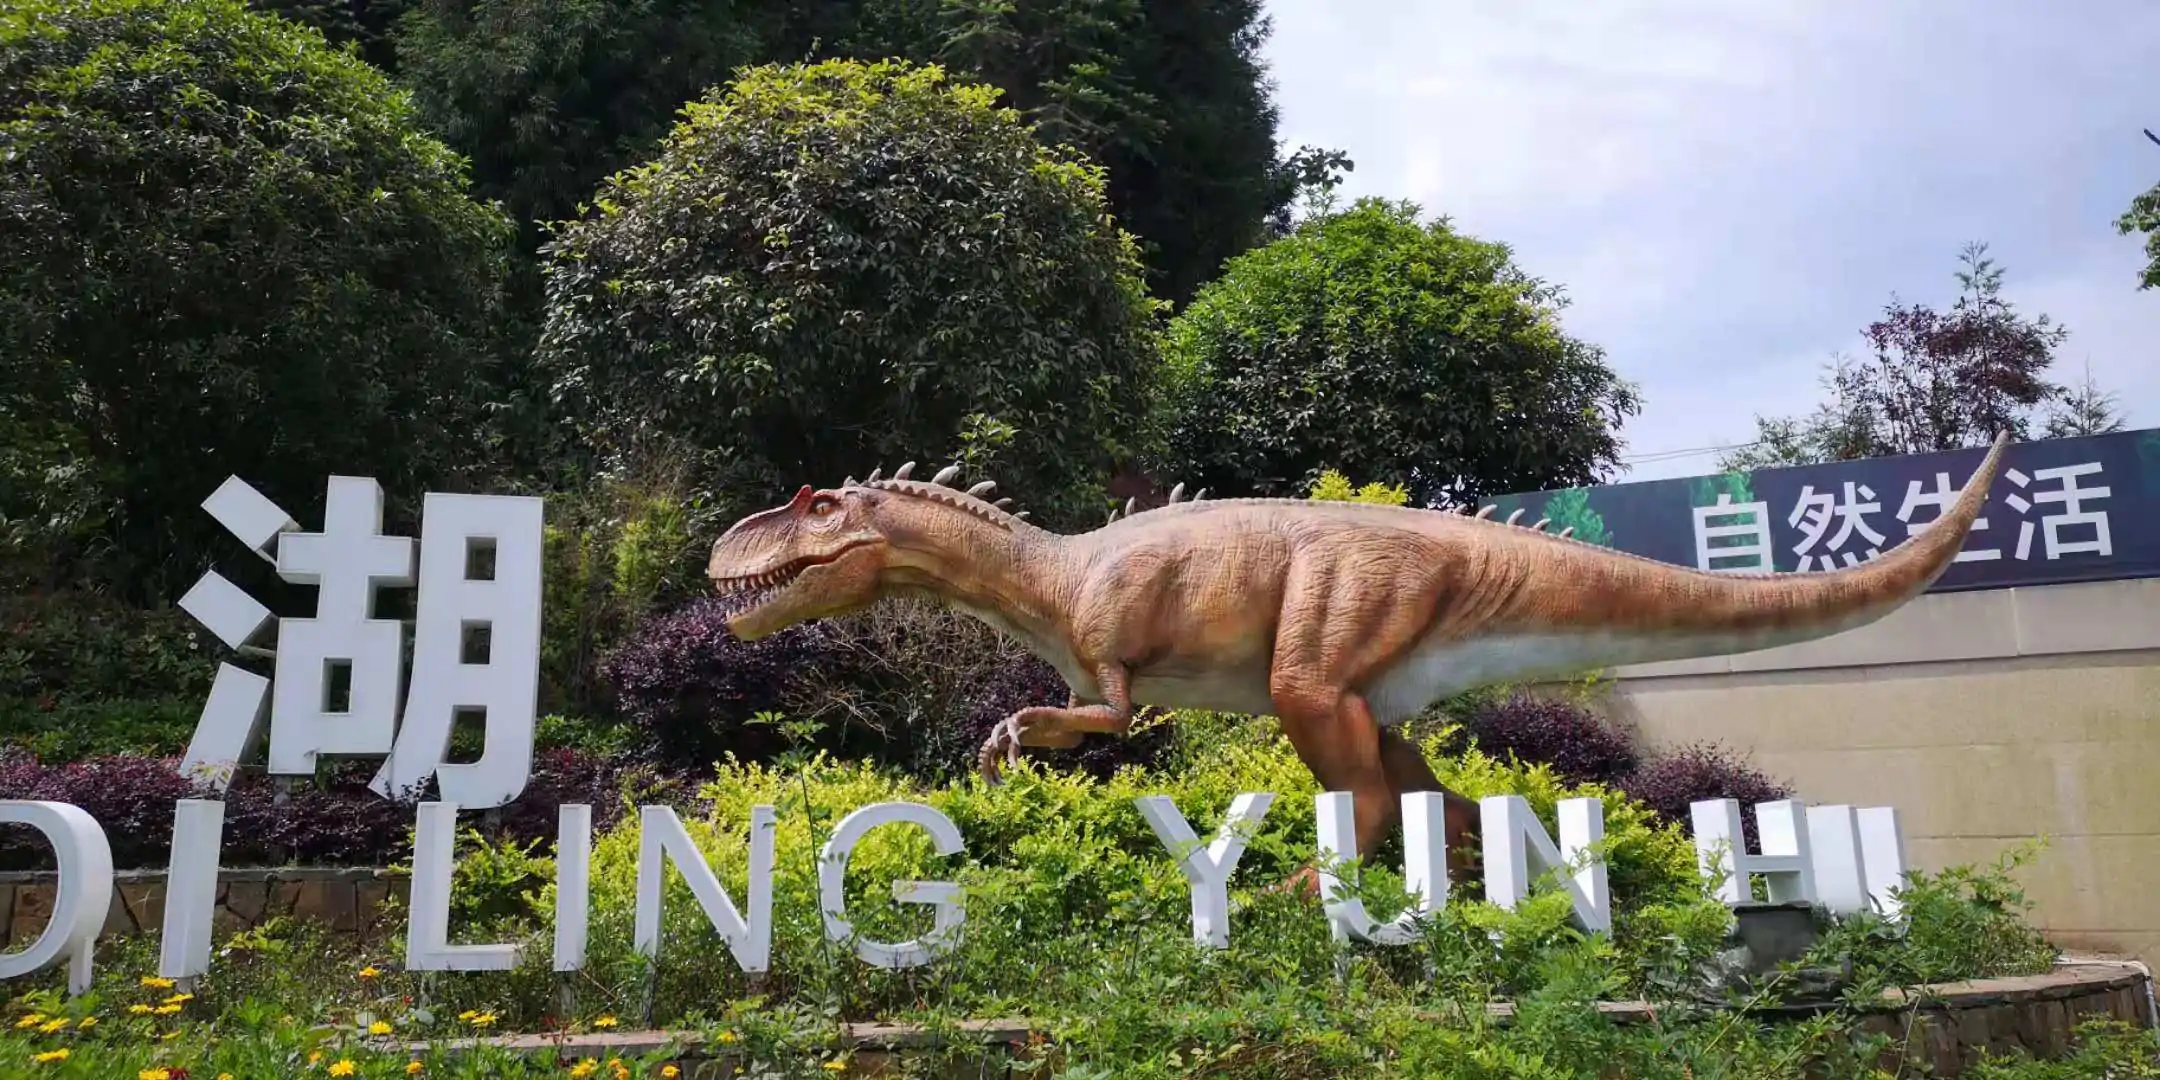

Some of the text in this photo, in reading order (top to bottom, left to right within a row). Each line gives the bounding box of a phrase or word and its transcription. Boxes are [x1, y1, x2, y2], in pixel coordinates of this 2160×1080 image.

[1692, 462, 2112, 574] 自然生活
[178, 474, 543, 810] 湖
[405, 801, 965, 973] LING
[1134, 790, 1612, 947] YUN
